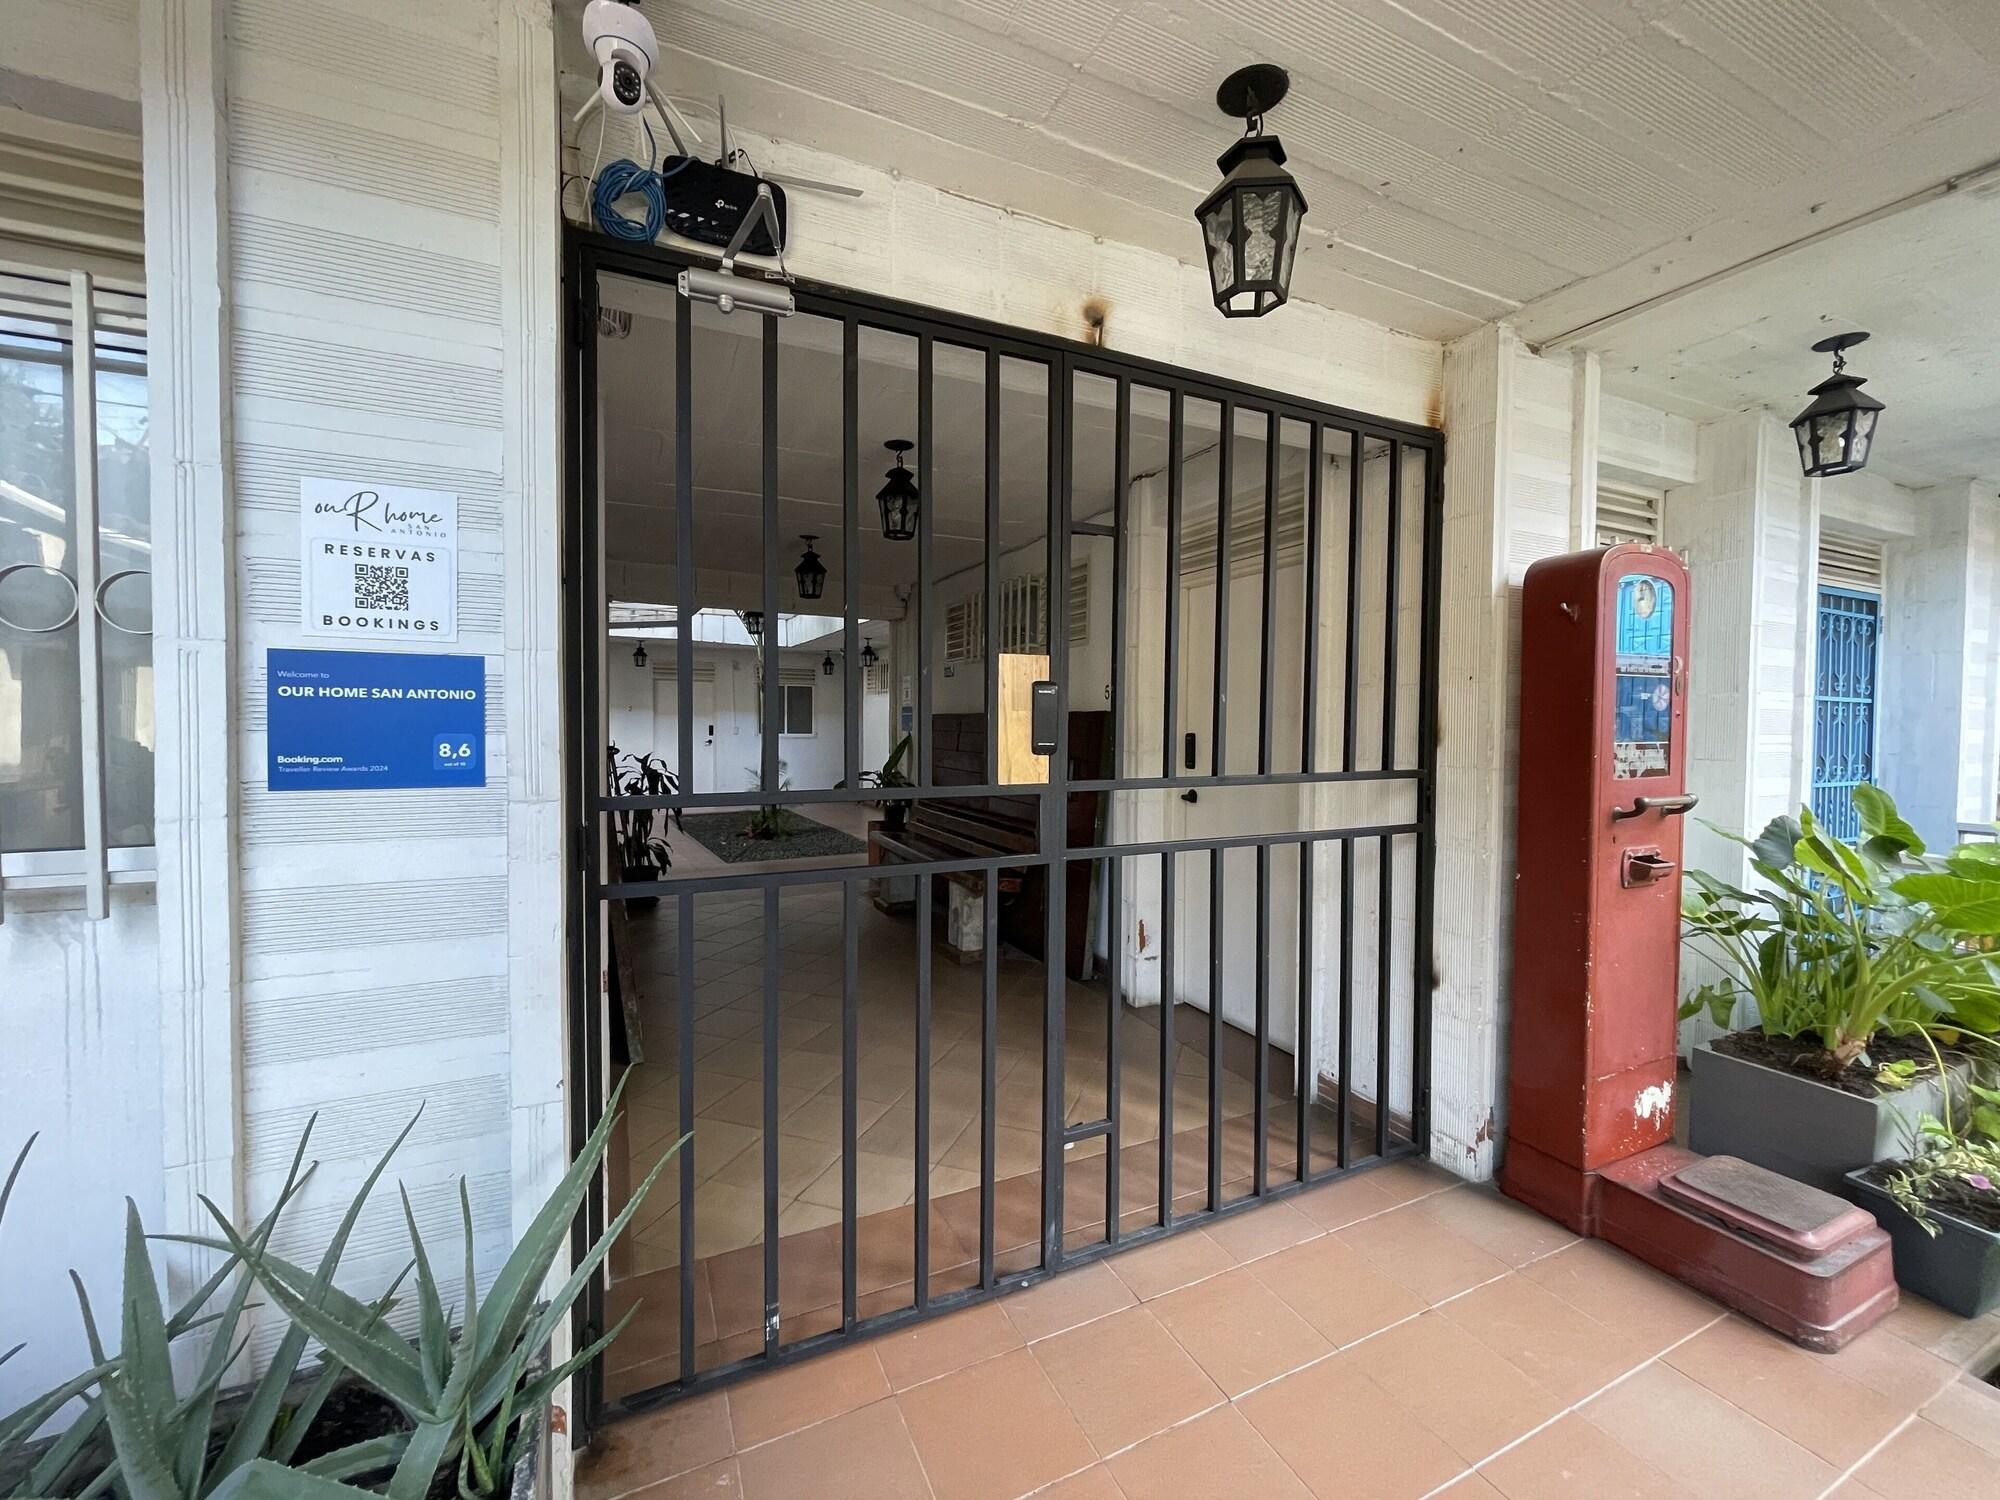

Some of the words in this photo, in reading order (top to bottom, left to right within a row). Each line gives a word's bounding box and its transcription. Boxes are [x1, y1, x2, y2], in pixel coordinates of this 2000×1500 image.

[385, 503, 443, 524] home
[390, 529, 447, 538] ANTONIO
[324, 543, 435, 562] RESERVAS
[323, 615, 439, 631] BOOKINGS
[277, 670, 319, 679] Welcome
[320, 671, 330, 679] to
[278, 685, 315, 697] OUR
[319, 686, 368, 698] HOME
[371, 687, 403, 699] SAN
[406, 688, 477, 700] ANTONIO
[439, 743, 471, 759] 8,6
[277, 755, 343, 765] Booking.com
